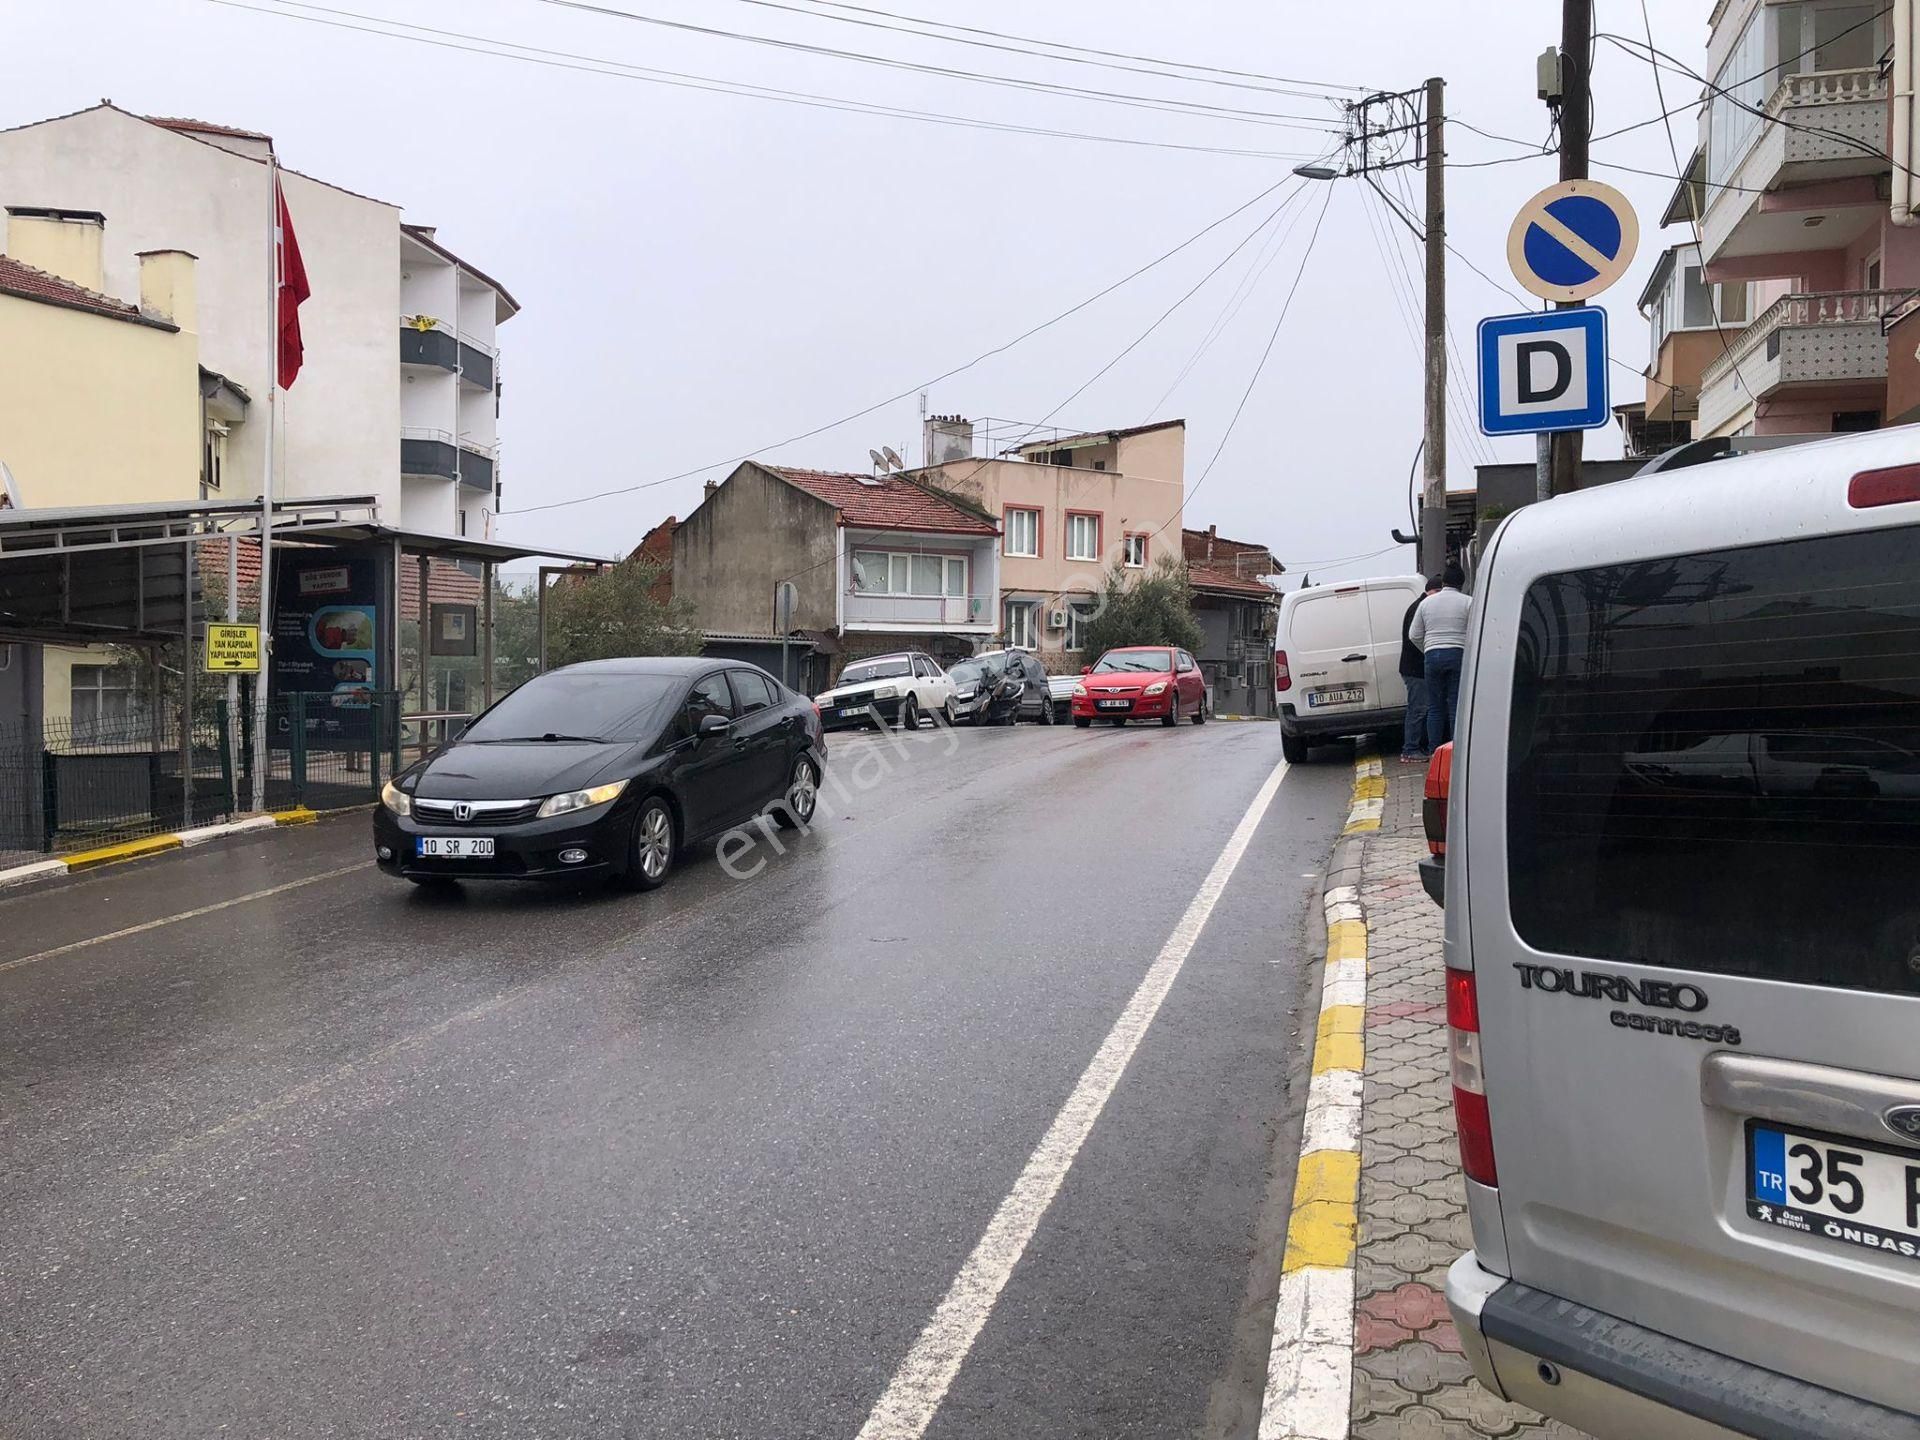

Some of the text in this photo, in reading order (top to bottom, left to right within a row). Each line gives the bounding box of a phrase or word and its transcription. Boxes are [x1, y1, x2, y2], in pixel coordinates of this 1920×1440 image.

[1516, 340, 1572, 404] D
[220, 629, 247, 639] GİRİŞLER
[214, 640, 253, 649] YAN KAPIDAN
[210, 650, 257, 660] YAPILMAKTADIR
[1315, 690, 1362, 703] 10 AUA 212
[425, 840, 437, 853] 10
[446, 840, 460, 854] SR
[471, 840, 493, 854] 200
[1512, 962, 1708, 1012] TOURNEO
[1759, 1170, 1783, 1191] TR
[1788, 1143, 1864, 1214] 35
[1783, 1210, 1803, 1222] Özel
